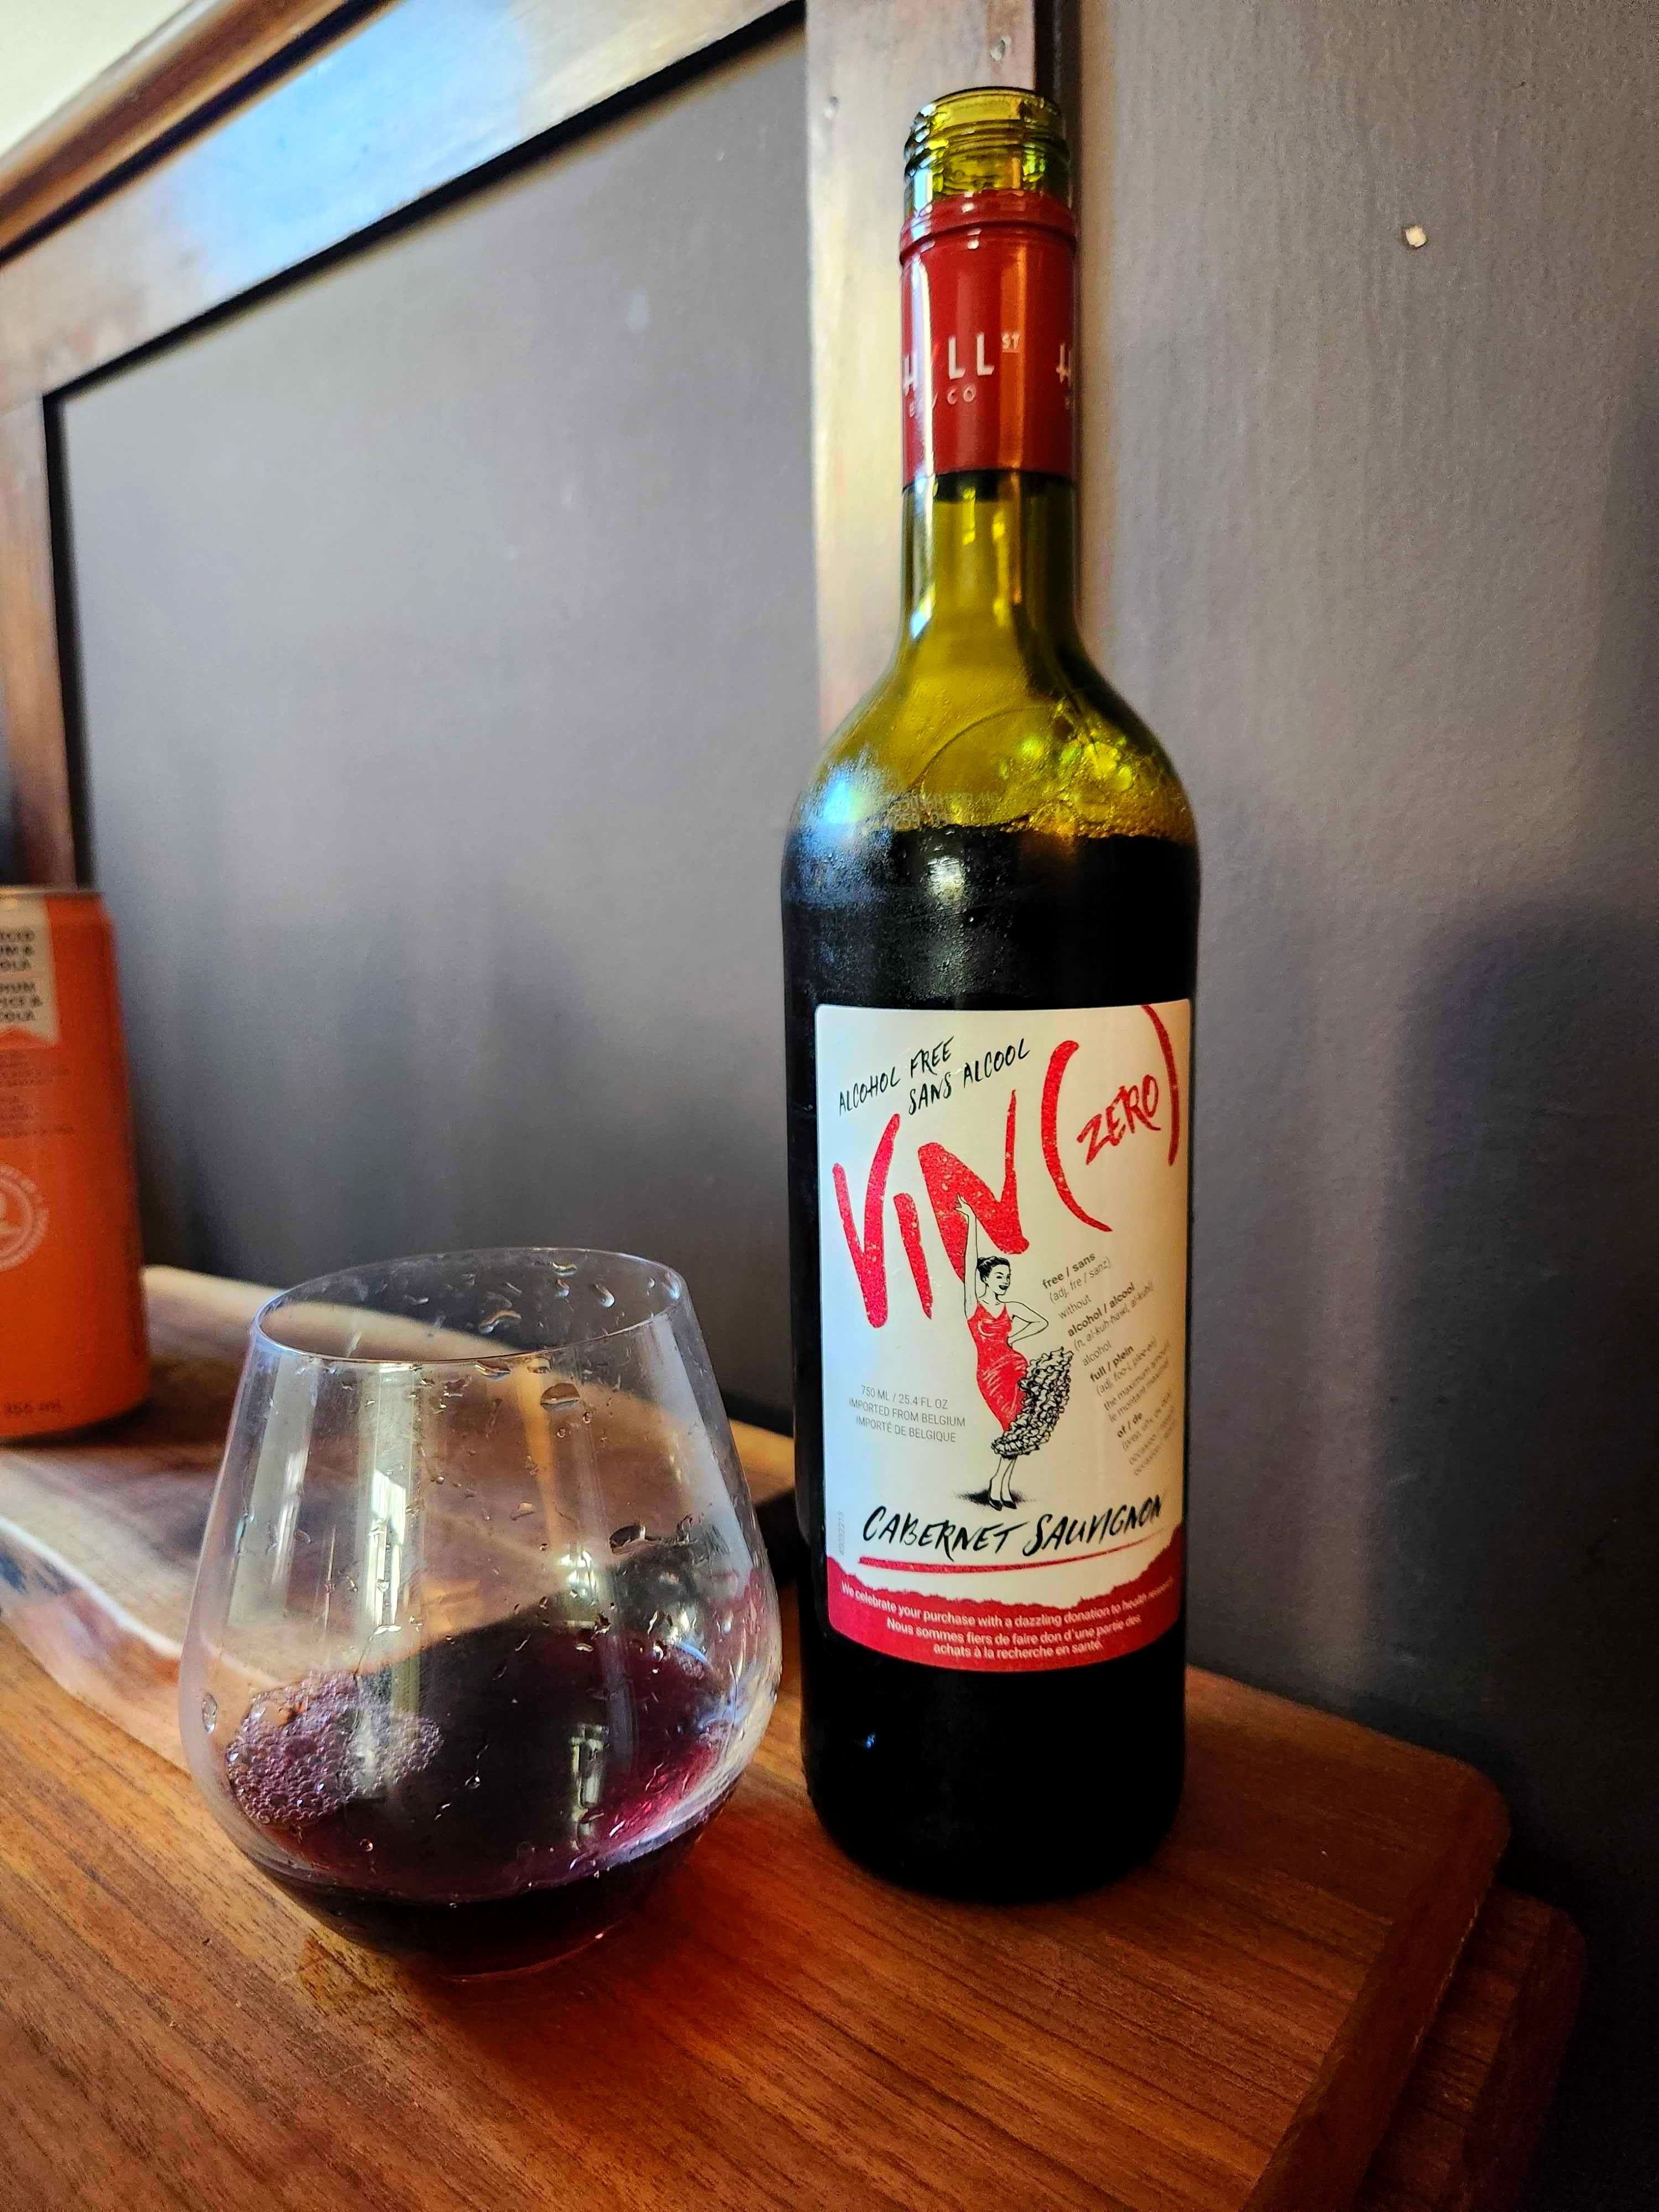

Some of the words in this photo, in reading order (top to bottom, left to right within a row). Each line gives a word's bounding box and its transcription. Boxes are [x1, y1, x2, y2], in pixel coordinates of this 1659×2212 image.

[838, 1066, 901, 1116] ALCOHOL
[910, 1035, 954, 1078] FREE
[908, 1071, 953, 1115] SANS
[963, 1037, 1031, 1089] ALCOOL
[1042, 1272, 1065, 1290] free
[1072, 1253, 1096, 1272] sans
[1058, 1294, 1092, 1319] without
[1067, 1307, 1103, 1337] alcohol
[1109, 1281, 1136, 1309] alcool
[1082, 1340, 1113, 1366] alcohol
[1090, 1365, 1107, 1383] full
[1112, 1345, 1134, 1368] plein
[849, 1397, 890, 1417] IMPORTED
[892, 1408, 919, 1423] FROM
[921, 1412, 966, 1427] BELGIUM
[861, 1385, 875, 1397] 750
[878, 1389, 890, 1401] ML
[899, 1394, 918, 1405] 25.4
[921, 1397, 932, 1408] FL
[935, 1398, 948, 1409] OZ
[856, 1415, 892, 1433] IMPORTÉ
[895, 1425, 907, 1436] DE
[909, 1427, 956, 1443] BELGIQUE
[863, 1505, 1030, 1562] CABERNET
[1022, 1494, 1162, 1557] SAUVIGNON
[841, 1580, 854, 1595] We
[855, 1590, 897, 1612] celebrate
[898, 1604, 921, 1619] your
[923, 1610, 975, 1626] purchase
[978, 1614, 1003, 1627] with
[1004, 1617, 1013, 1627] a
[1014, 1613, 1062, 1627] dazzling
[1063, 1606, 1110, 1623] donation
[1110, 1603, 1121, 1615] to
[886, 1616, 914, 1635] Nous
[915, 1626, 965, 1644] sommes
[967, 1631, 993, 1645] fiers
[995, 1632, 1010, 1645] de
[1012, 1632, 1039, 1646] faire
[1040, 1631, 1062, 1644] don
[1095, 1619, 1125, 1637] partie
[933, 1642, 971, 1657] achats
[973, 1645, 982, 1658] à
[984, 1646, 995, 1658] la
[997, 1645, 1054, 1659] recherche
[1055, 1644, 1070, 1656] en
